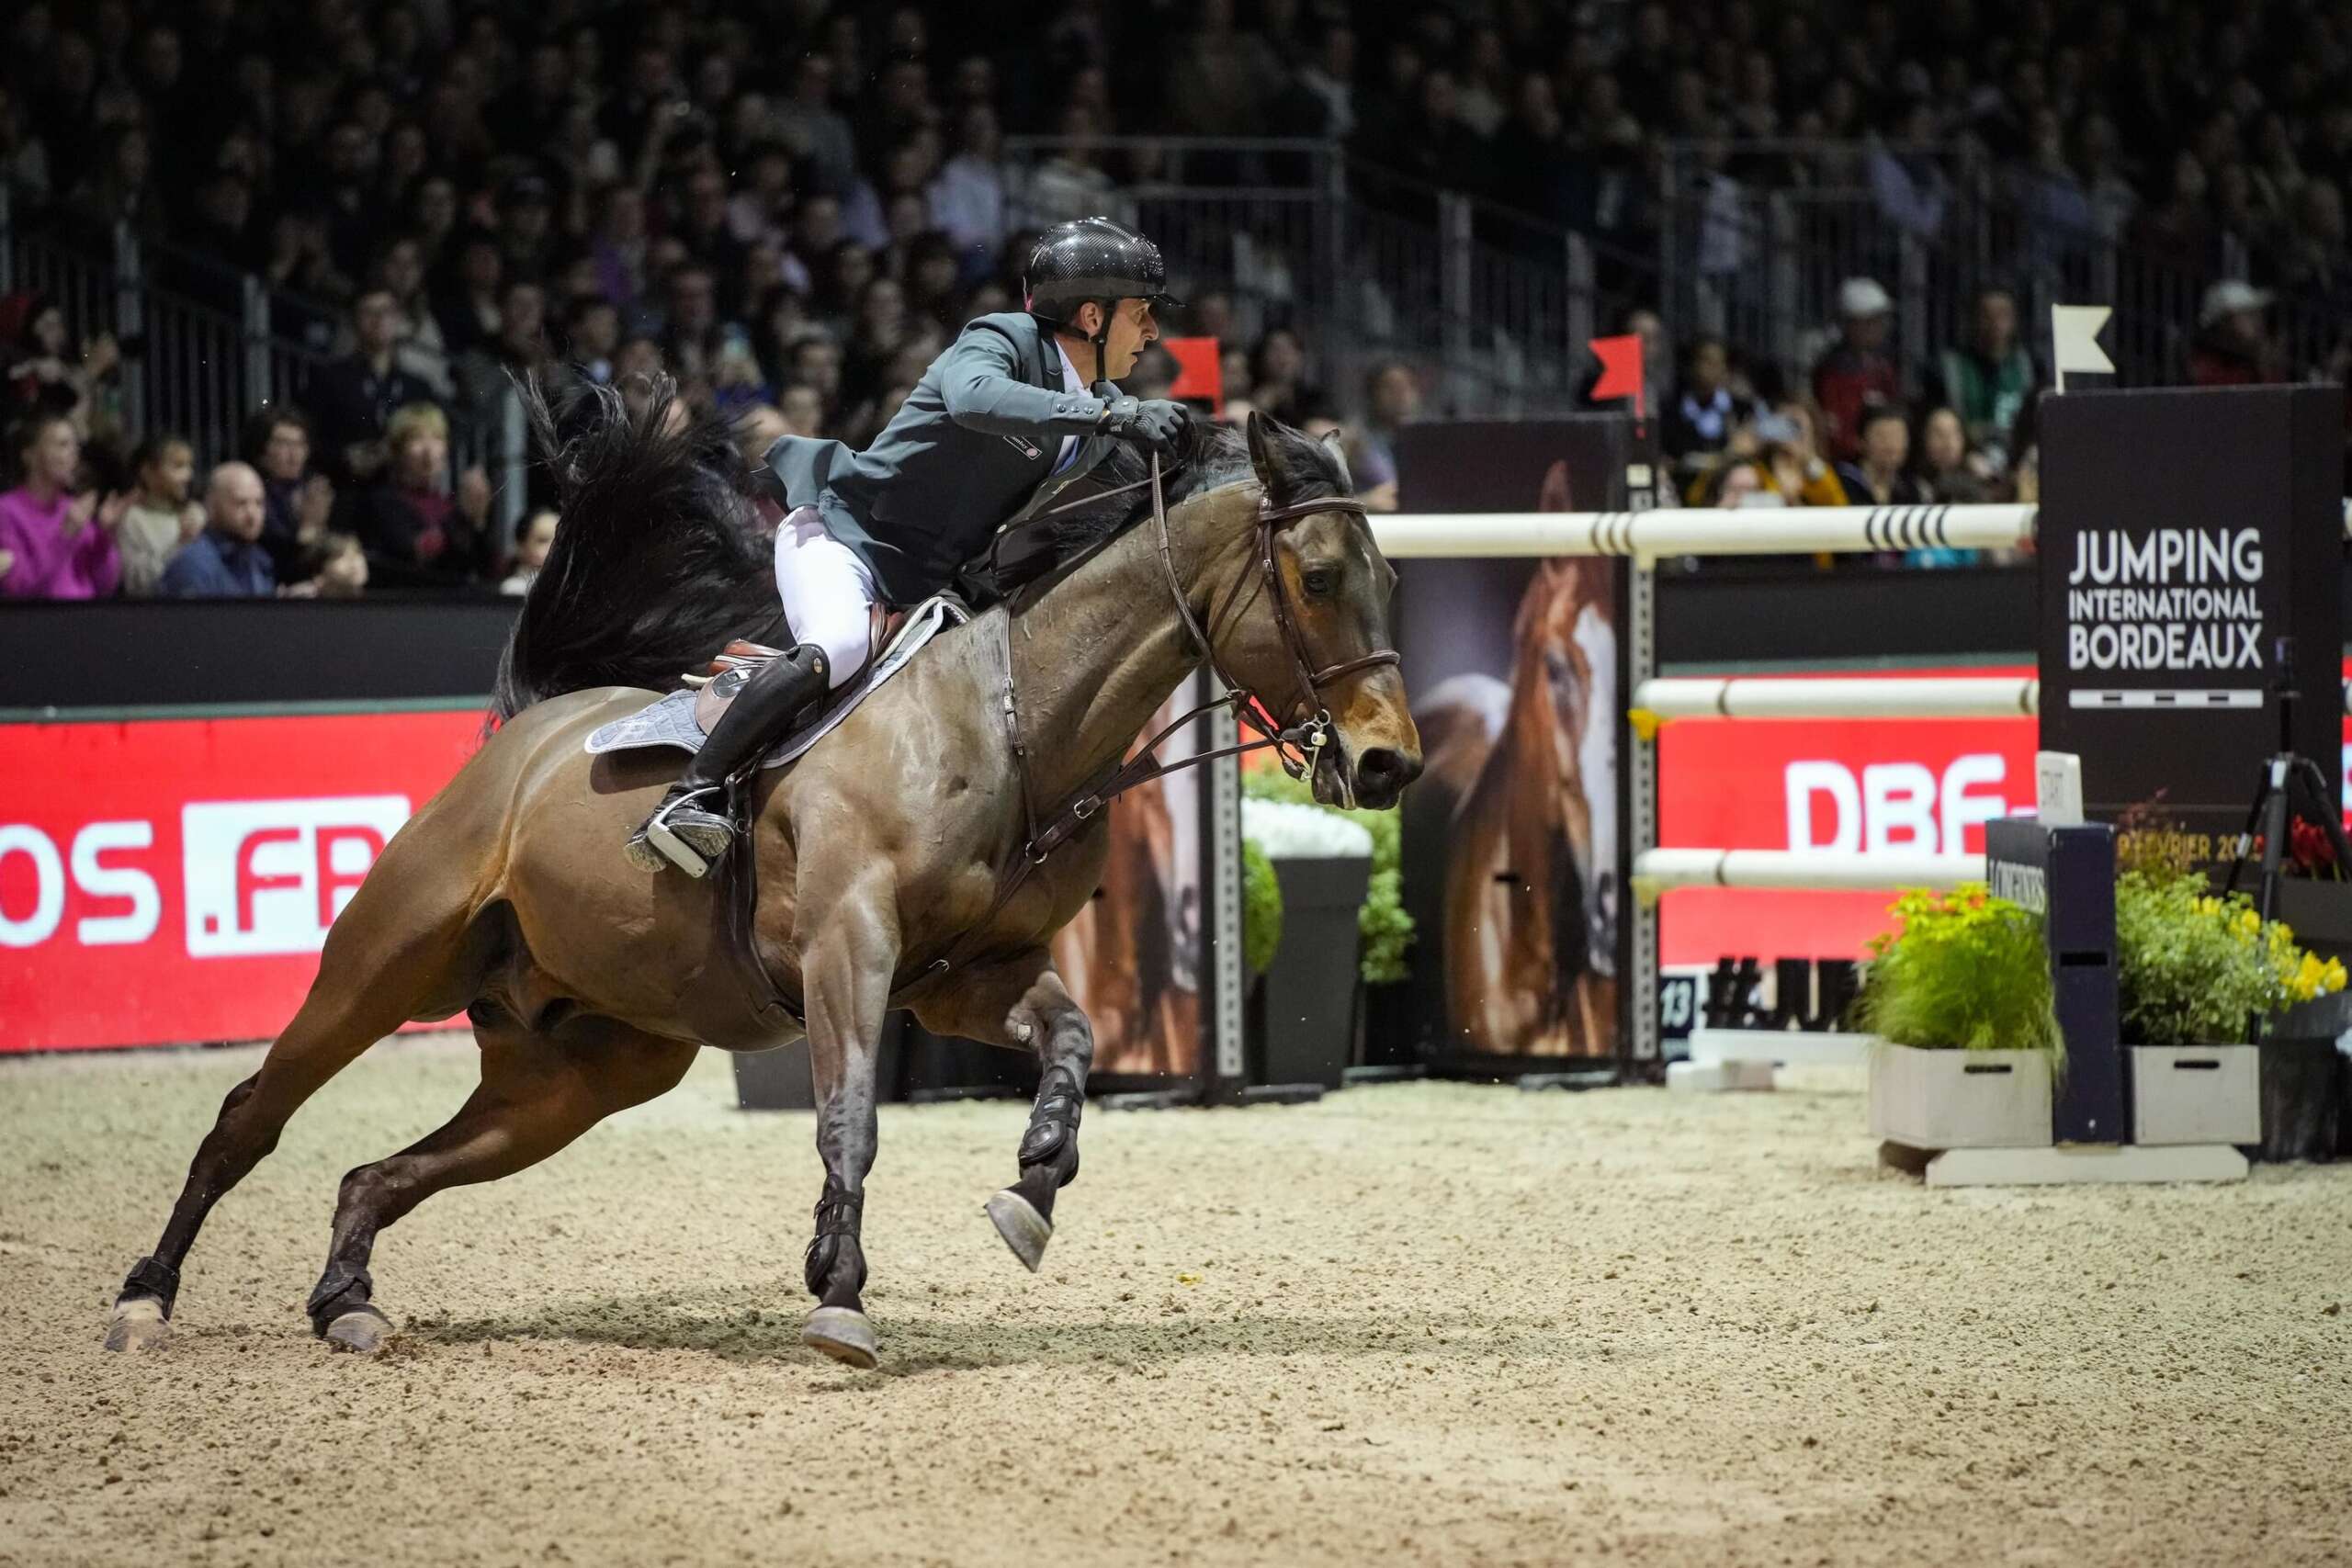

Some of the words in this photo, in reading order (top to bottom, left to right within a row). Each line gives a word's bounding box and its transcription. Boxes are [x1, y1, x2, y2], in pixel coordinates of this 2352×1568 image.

[2068, 528, 2263, 585] JUMPING
[2068, 589, 2263, 621] INTERNATIONAL
[2068, 623, 2263, 670] BORDEAUX
